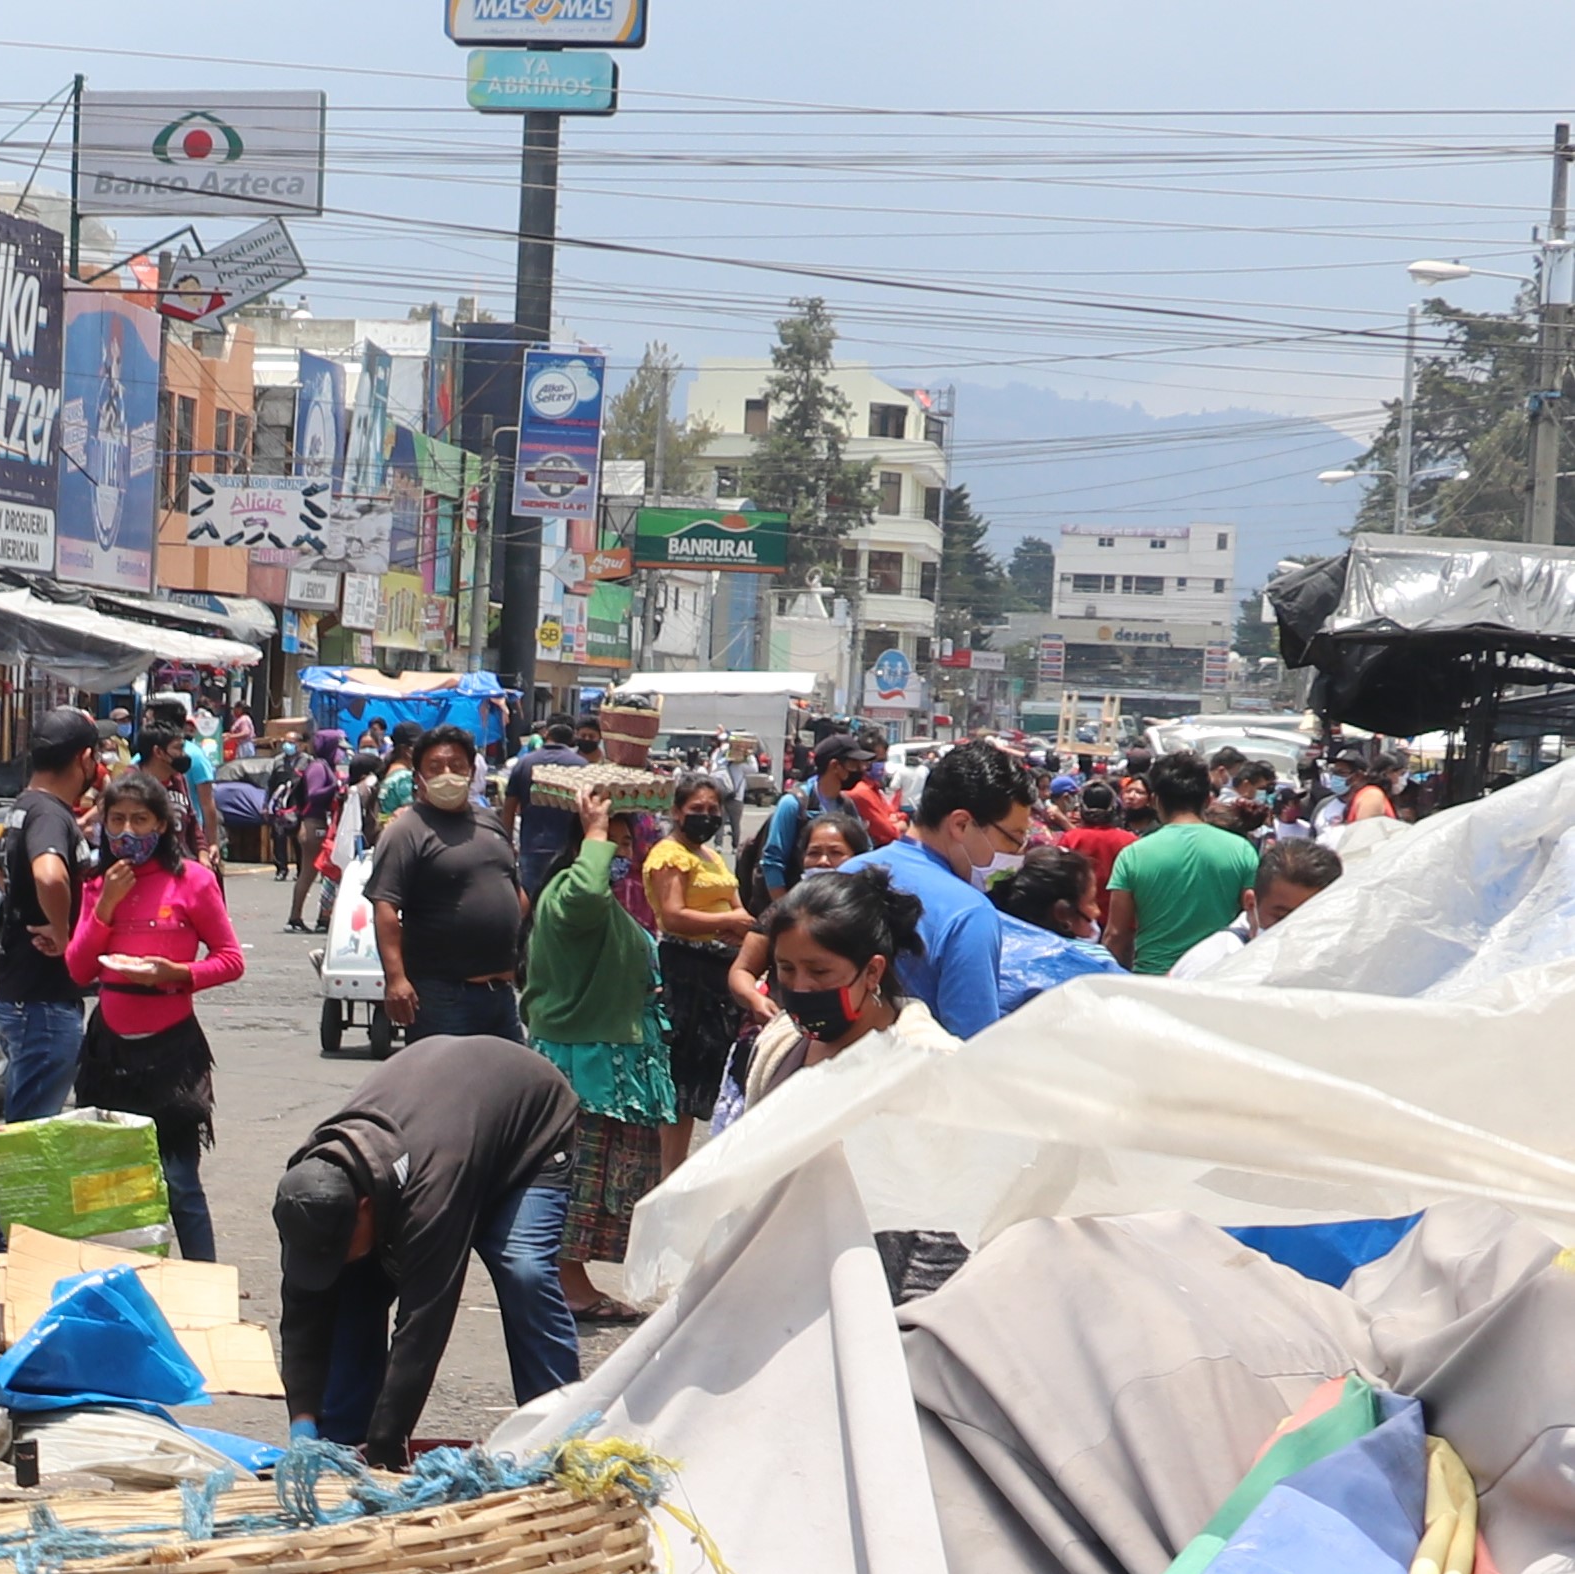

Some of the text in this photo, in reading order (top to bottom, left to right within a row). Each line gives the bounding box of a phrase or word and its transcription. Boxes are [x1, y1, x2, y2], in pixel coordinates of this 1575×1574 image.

[523, 57, 551, 74] YA
[487, 76, 593, 96] ABRIMOS
[94, 170, 305, 195] Banco Azteca
[211, 229, 283, 270] Préstamos
[217, 243, 291, 285] Personales
[230, 491, 284, 510] Alicia
[5, 508, 48, 537] DROGUERIA
[668, 537, 757, 558] BANRURAL
[588, 564, 602, 574] es
[593, 553, 626, 571] Aquí
[540, 627, 559, 642] 5B
[1114, 627, 1172, 643] deseret
